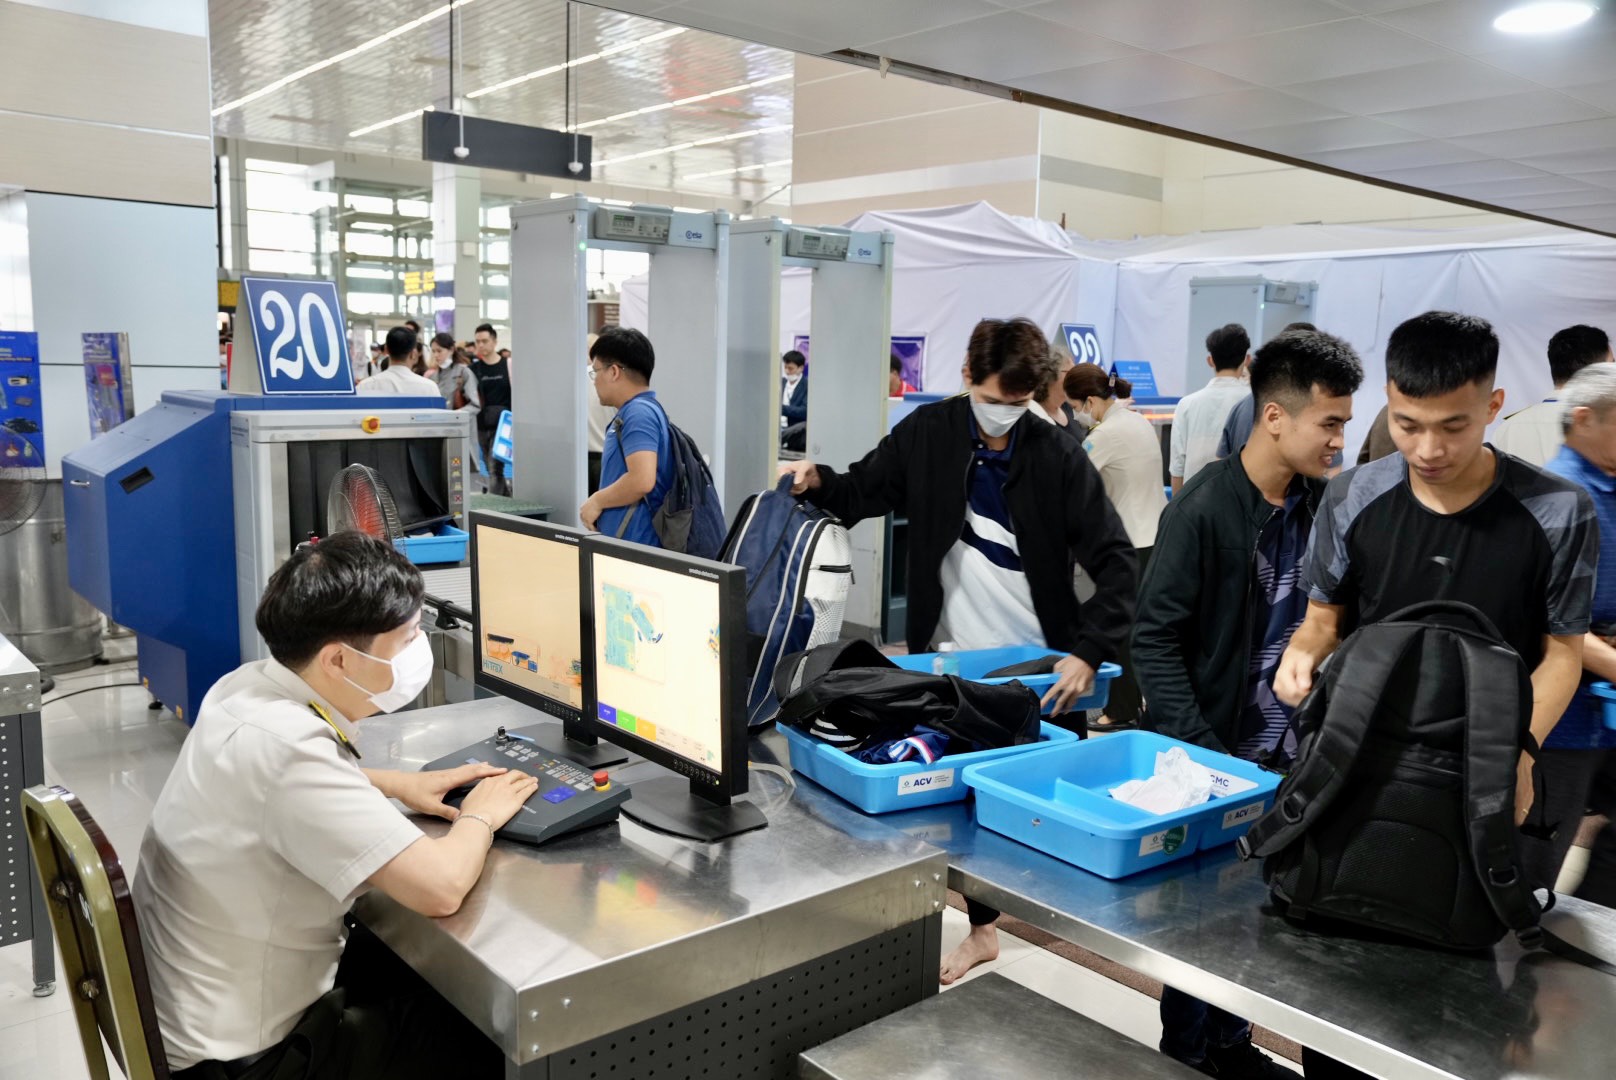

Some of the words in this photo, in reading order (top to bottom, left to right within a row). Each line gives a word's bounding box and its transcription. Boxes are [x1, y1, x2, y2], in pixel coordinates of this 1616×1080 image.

[260, 290, 340, 380] 20
[913, 776, 932, 787] ACV
[1234, 807, 1249, 819] ACV
